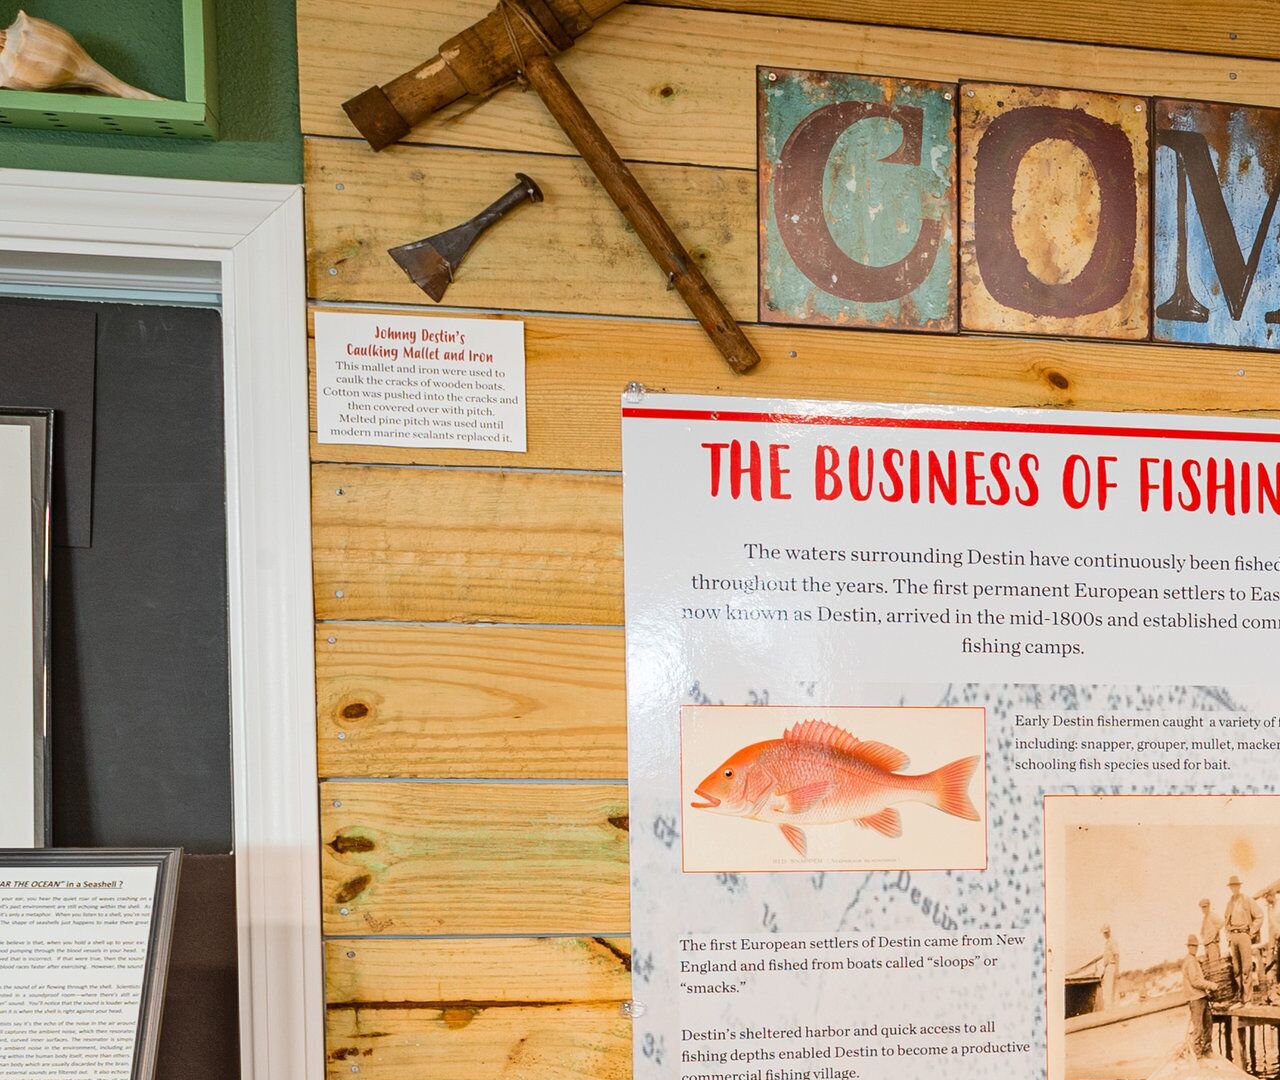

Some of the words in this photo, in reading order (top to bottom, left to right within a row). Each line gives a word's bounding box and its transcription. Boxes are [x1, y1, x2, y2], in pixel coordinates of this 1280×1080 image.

[375, 327, 416, 344] Johnny
[421, 328, 464, 345] Destin's
[345, 343, 399, 359] Caulking
[402, 345, 439, 360] Mallet
[443, 348, 464, 361] and
[468, 351, 494, 364] Iron
[701, 439, 791, 502] THE
[814, 445, 1039, 507] BUSINESS
[1062, 454, 1118, 511] OF
[743, 543, 780, 559] The
[785, 546, 846, 561] waters
[851, 547, 963, 568] surrounding
[967, 549, 1025, 565] Destin
[1029, 550, 1069, 566] have
[1074, 553, 1186, 573] continuously
[1189, 554, 1230, 570] been
[14, 880, 29, 888] THE
[83, 880, 116, 888] Seashell
